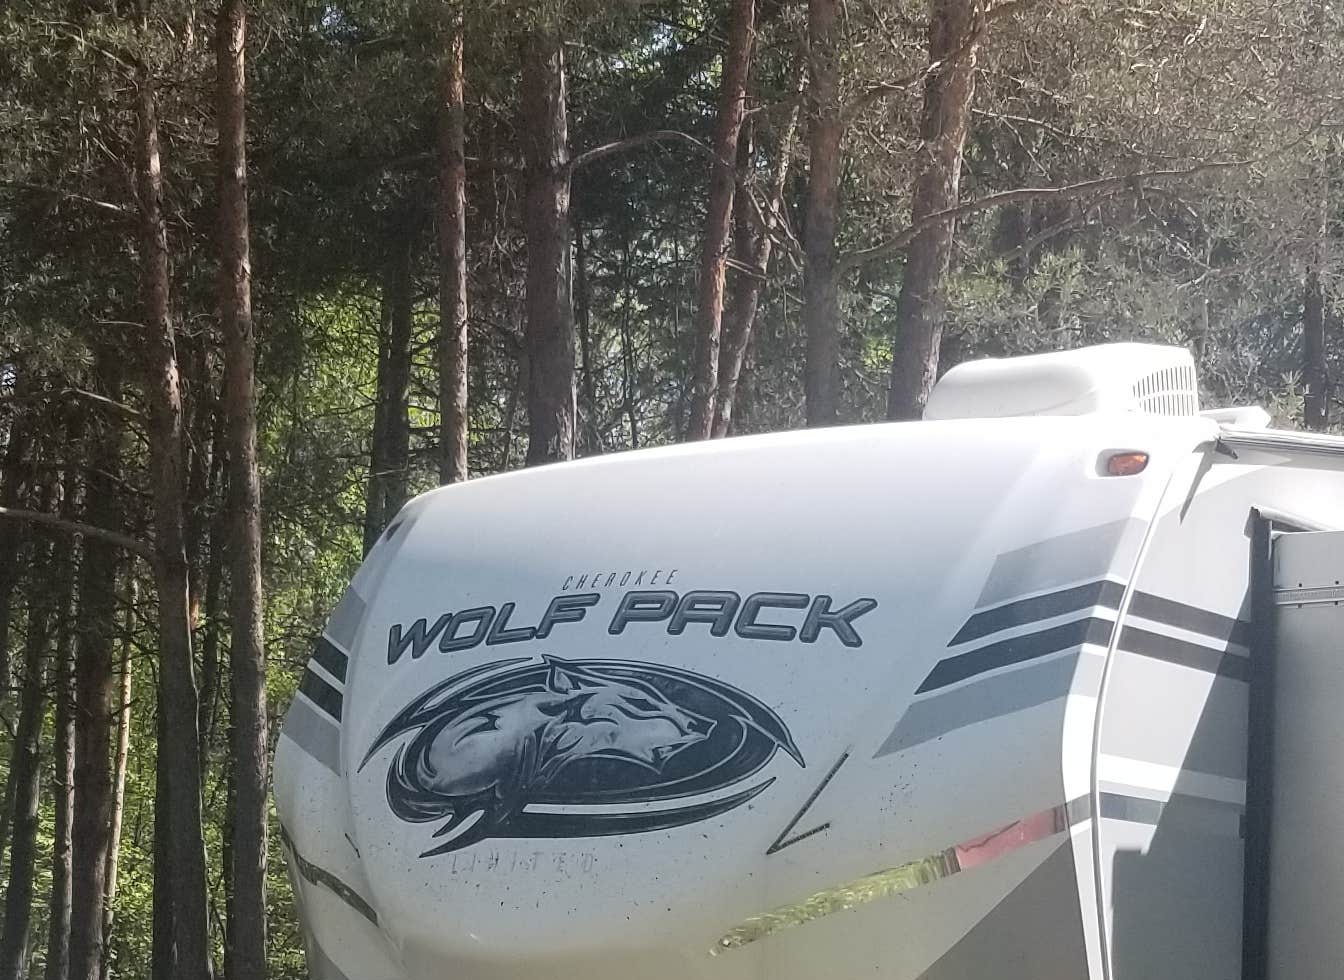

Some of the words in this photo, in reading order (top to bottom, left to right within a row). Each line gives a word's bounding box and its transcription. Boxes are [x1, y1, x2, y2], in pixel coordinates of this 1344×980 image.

[562, 569, 678, 591] CHEROKEE
[387, 592, 600, 665] WOLF
[607, 589, 878, 648] PACK
